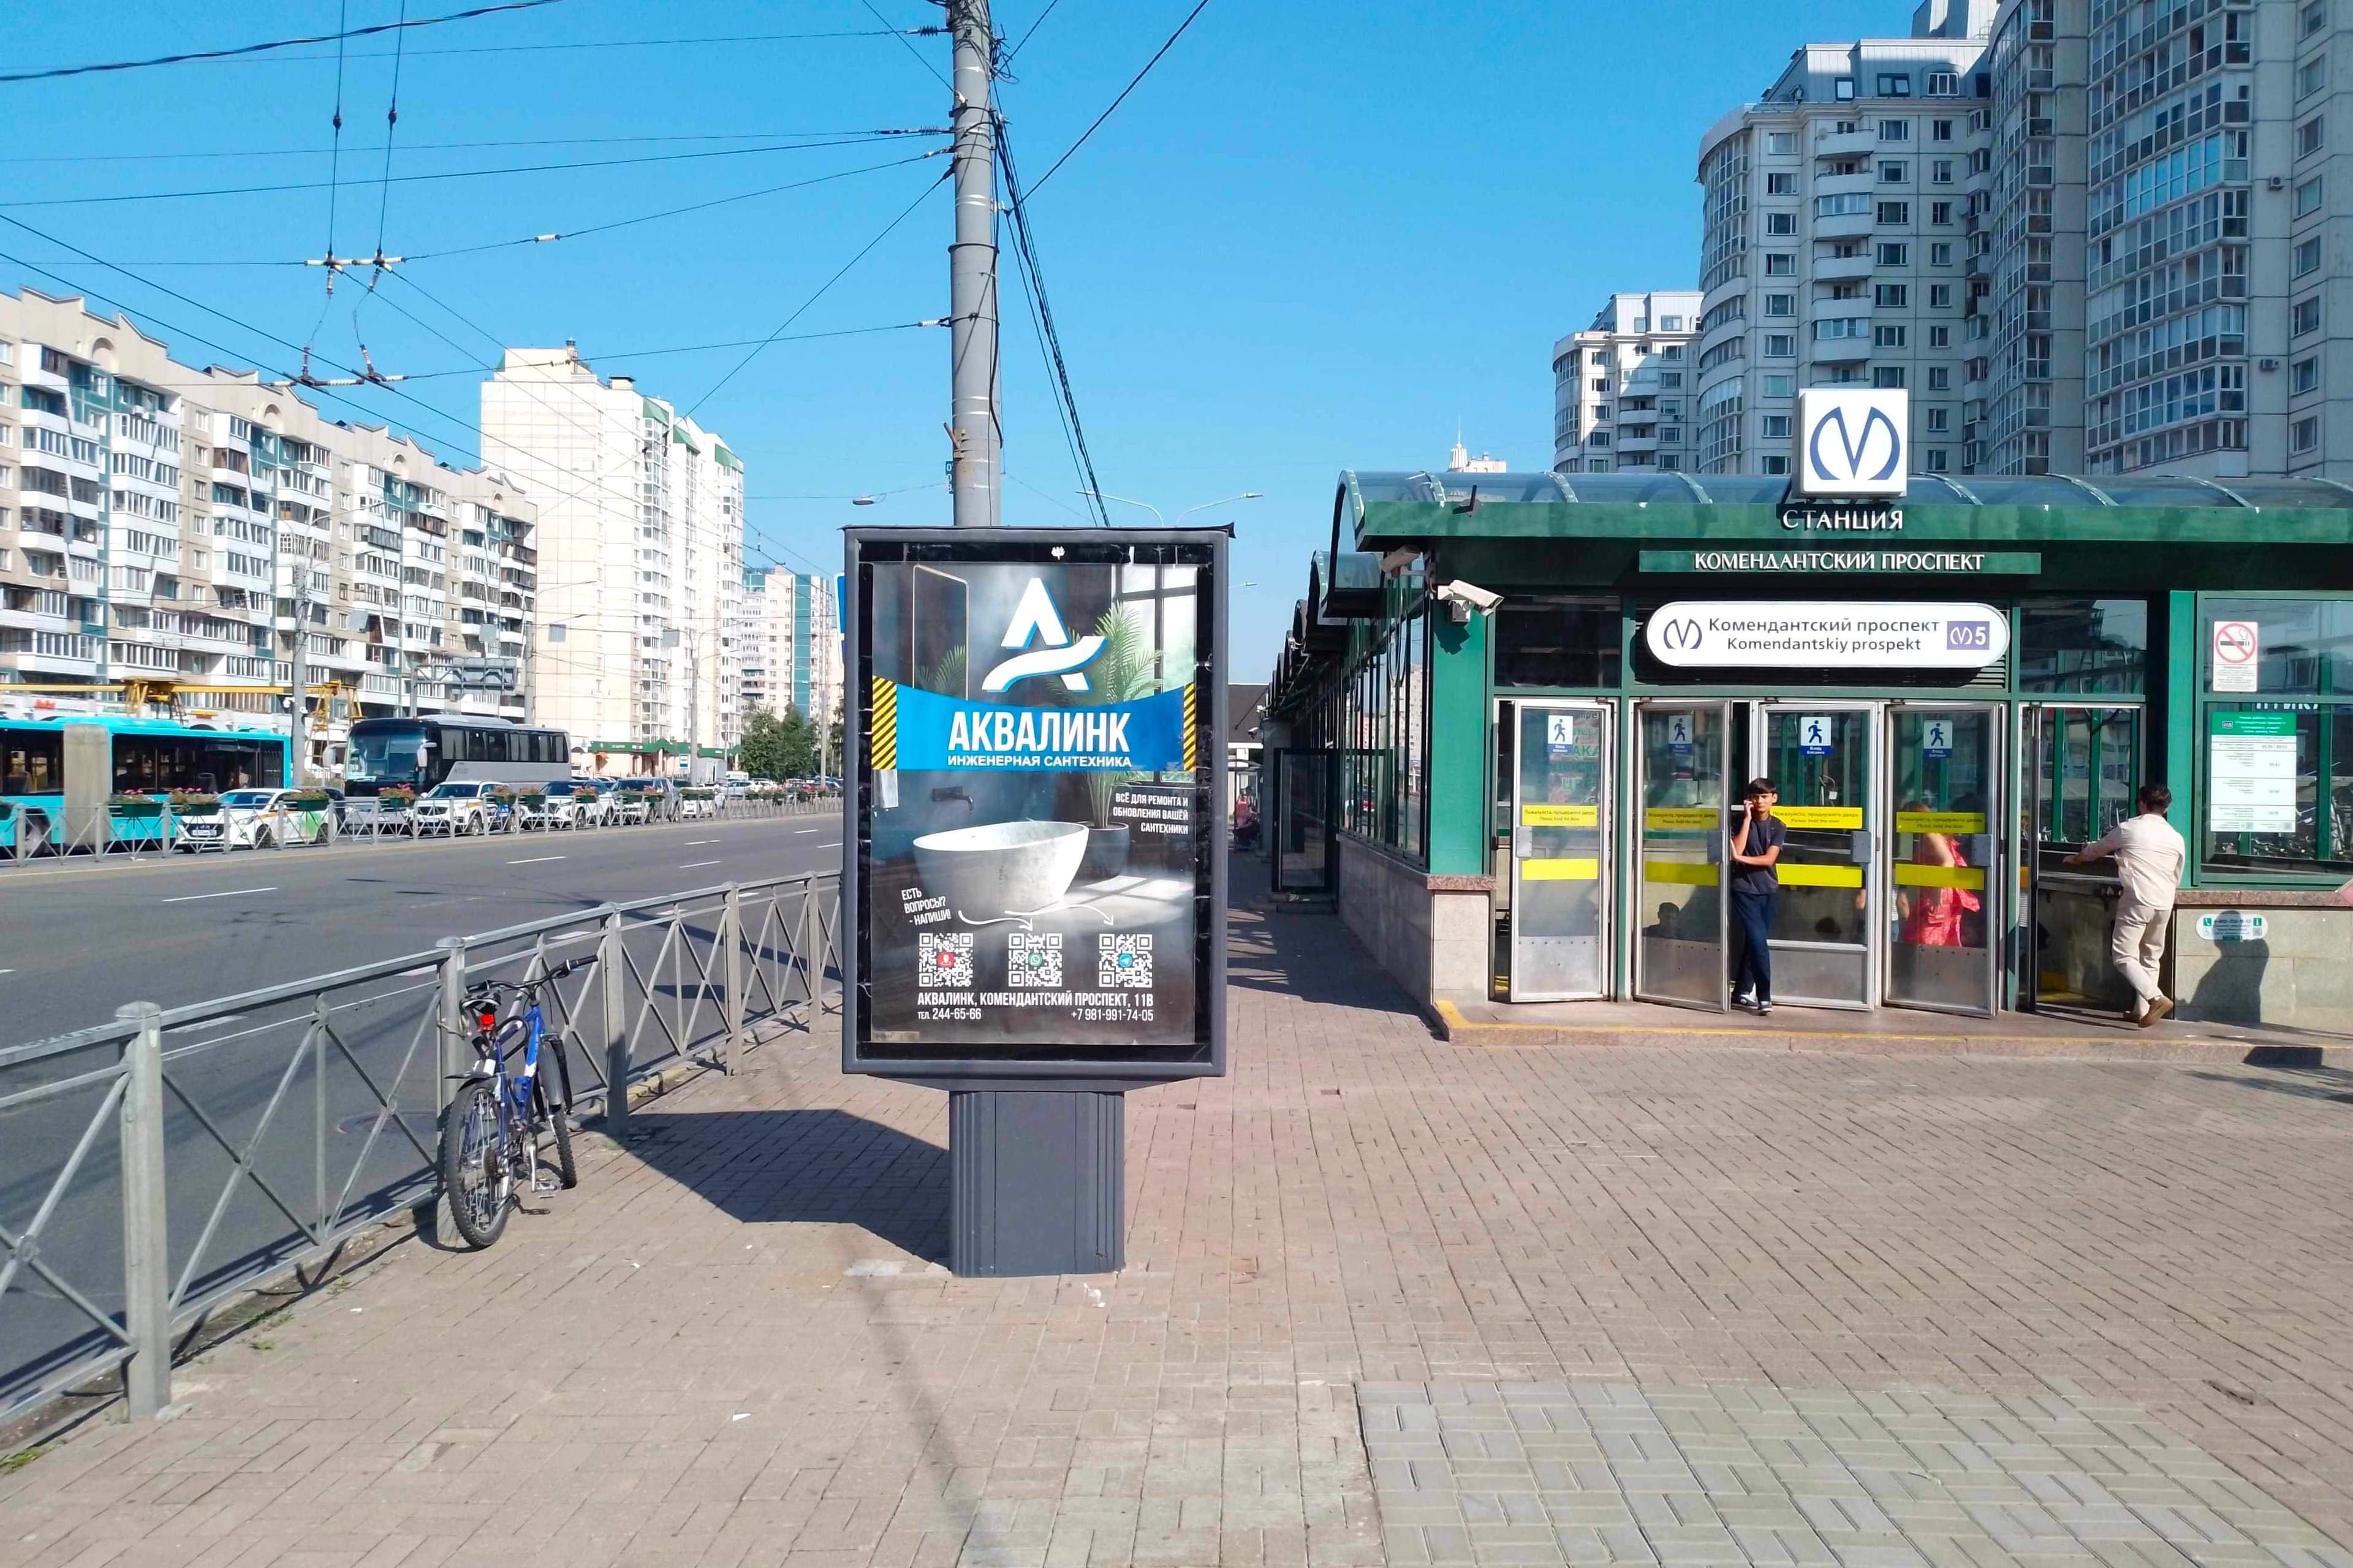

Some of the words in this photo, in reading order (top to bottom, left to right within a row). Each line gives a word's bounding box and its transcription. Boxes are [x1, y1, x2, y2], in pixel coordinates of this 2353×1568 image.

[1783, 509, 1903, 531] СТАНЦИЯ
[1694, 552, 1875, 570] КОМЕНДАНТСКИЙ
[1882, 553, 1985, 571] ПРОСПЕКТ
[1708, 617, 1852, 633] Комендантский
[1857, 621, 1940, 634] проспект
[1974, 626, 1987, 646] 5
[1727, 637, 1847, 653] Komendantskiy
[1852, 638, 1922, 653] prospekt
[947, 711, 1131, 752] АКВАЛИНК
[947, 755, 1040, 767] ИНЖЕНЕРНАЯ
[1044, 756, 1132, 767] САНТЕХНИКА
[1115, 792, 1129, 803] ВСЁ
[1131, 793, 1147, 805] ДЛЯ
[1148, 795, 1181, 806] РЕМОНТА
[1183, 797, 1189, 807] И
[1113, 806, 1161, 819] ОБНОВЛЕНИЯ
[1162, 808, 1189, 821] ВАШЕЙ
[1140, 822, 1189, 835] САНТЕХНИКИ
[901, 887, 922, 901] ЕСТЬ
[904, 896, 946, 914] ВОПРОСЫ?
[914, 908, 951, 926] НАПИШИ!
[917, 992, 977, 1007] АКВАЛИНК,
[980, 990, 1072, 1007] КОМЕНДАНТСКИЙ
[1074, 993, 1131, 1008] ПРОСПЕКТ,
[932, 1008, 982, 1020] 244-65-66
[1071, 1009, 1083, 1020] +7
[1085, 1009, 1154, 1021] 981-991-74-05
